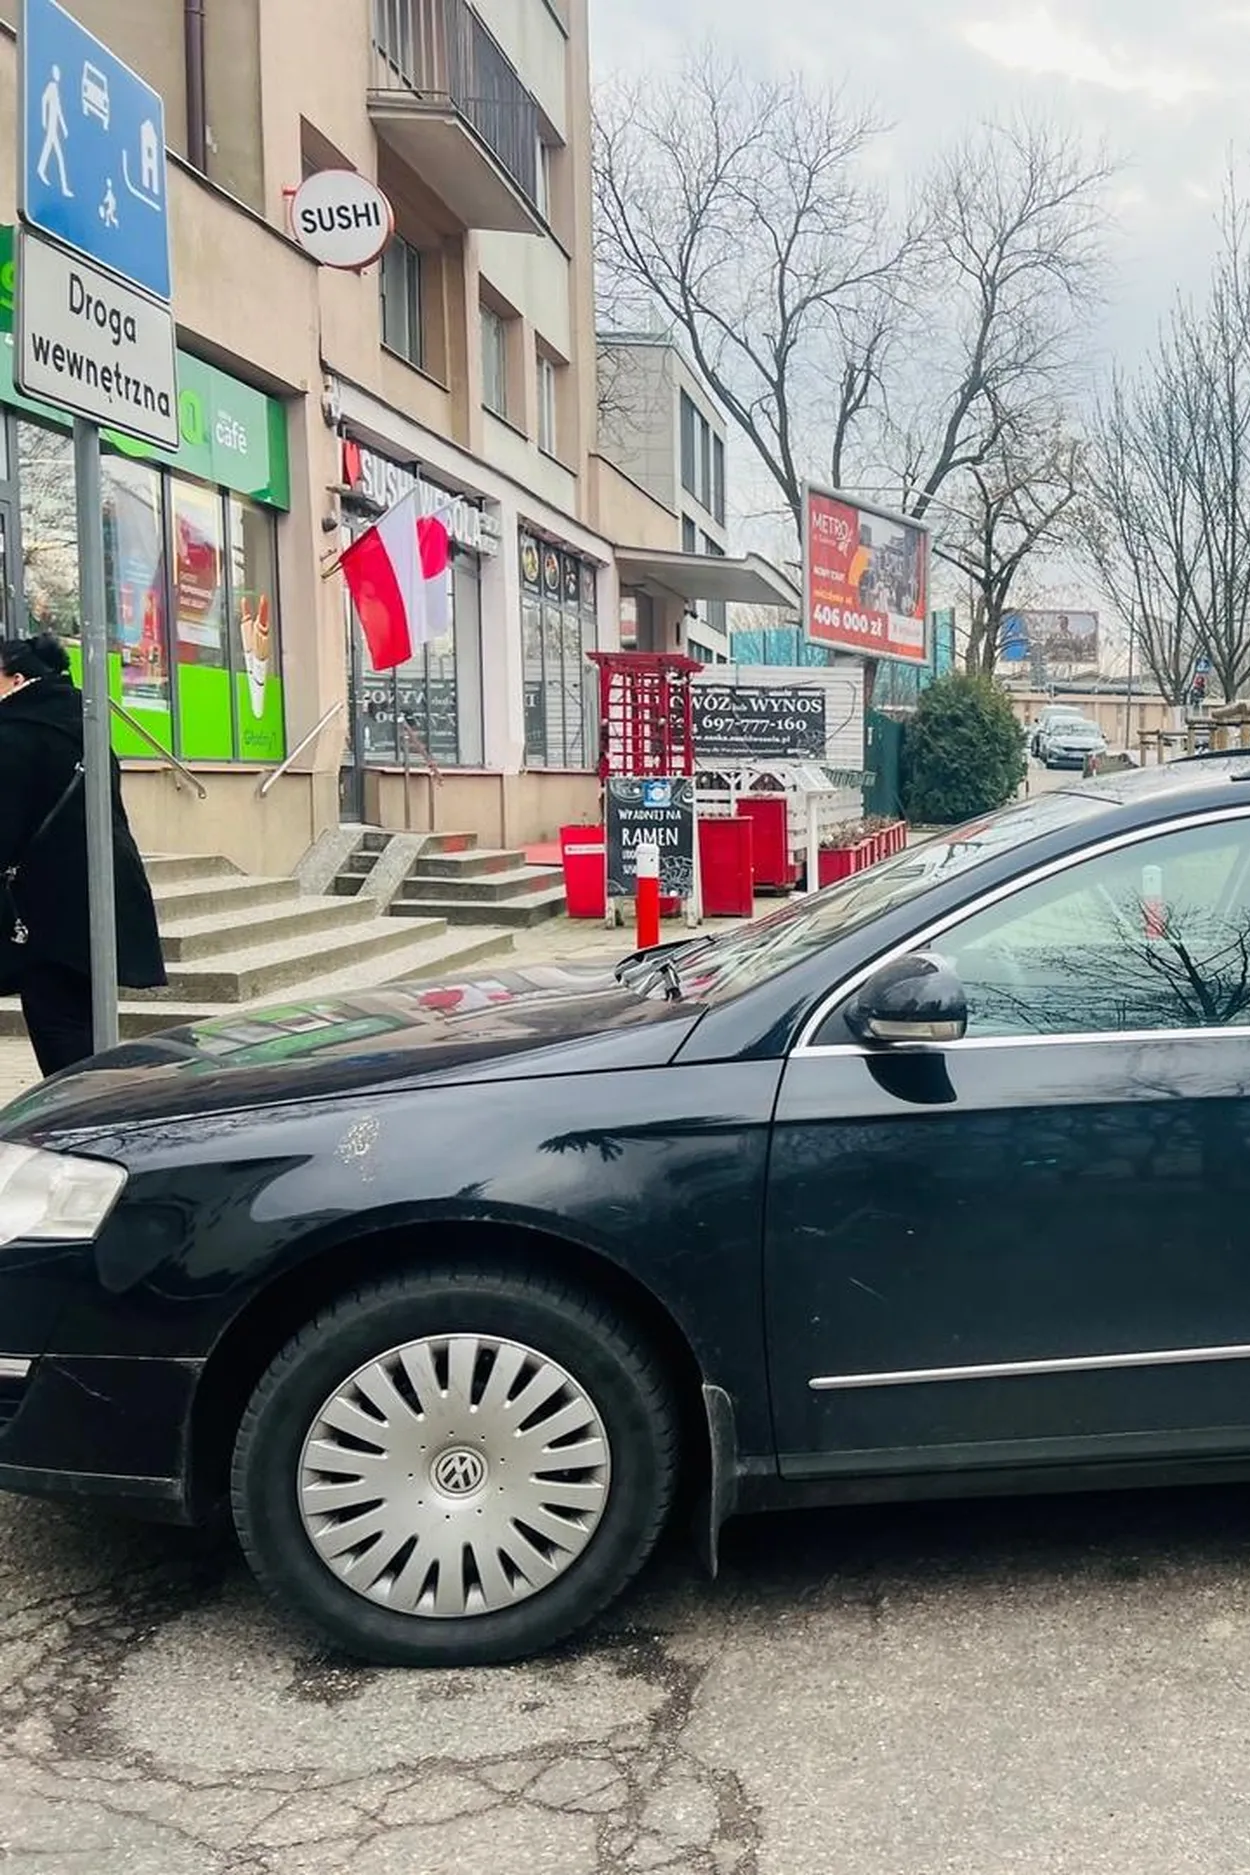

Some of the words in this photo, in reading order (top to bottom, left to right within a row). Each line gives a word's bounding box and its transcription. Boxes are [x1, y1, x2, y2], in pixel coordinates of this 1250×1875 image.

[301, 202, 380, 234] SUSHI
[69, 272, 136, 346] Droga
[31, 333, 171, 418] wewnętrzna
[813, 604, 840, 627] 406
[843, 611, 869, 635] 000
[870, 617, 883, 637] zł
[750, 699, 823, 713] WYNOS
[702, 714, 807, 732] 697-777-160
[622, 827, 679, 846] RAMEN
